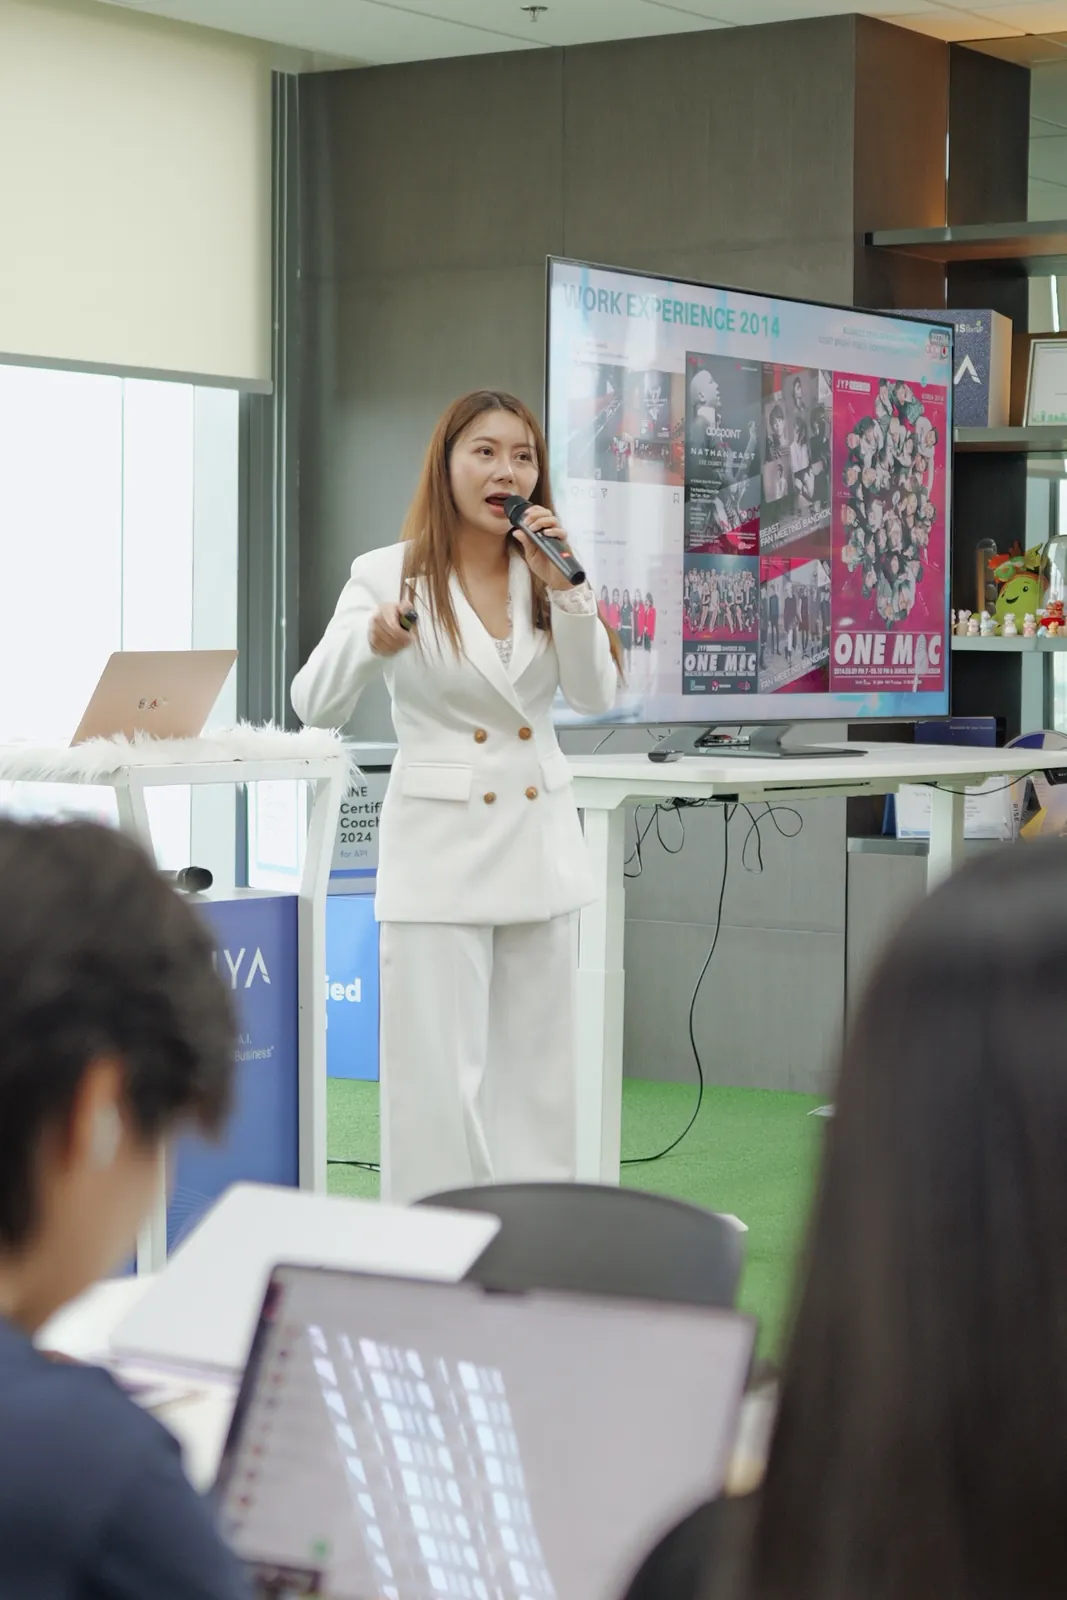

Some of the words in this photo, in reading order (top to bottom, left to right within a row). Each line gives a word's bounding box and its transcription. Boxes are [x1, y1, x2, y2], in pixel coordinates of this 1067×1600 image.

[563, 283, 622, 317] WORK
[627, 292, 736, 333] EXPERIENCE
[740, 311, 781, 339] 2014
[691, 447, 730, 459] NATHAN
[732, 451, 756, 461] EAST
[760, 522, 780, 539] BEAST
[760, 534, 775, 548] FAN
[834, 633, 887, 665] ONE
[684, 653, 718, 672] ONE
[340, 832, 372, 844] 2024
[341, 850, 352, 859] for
[354, 850, 368, 858] API
